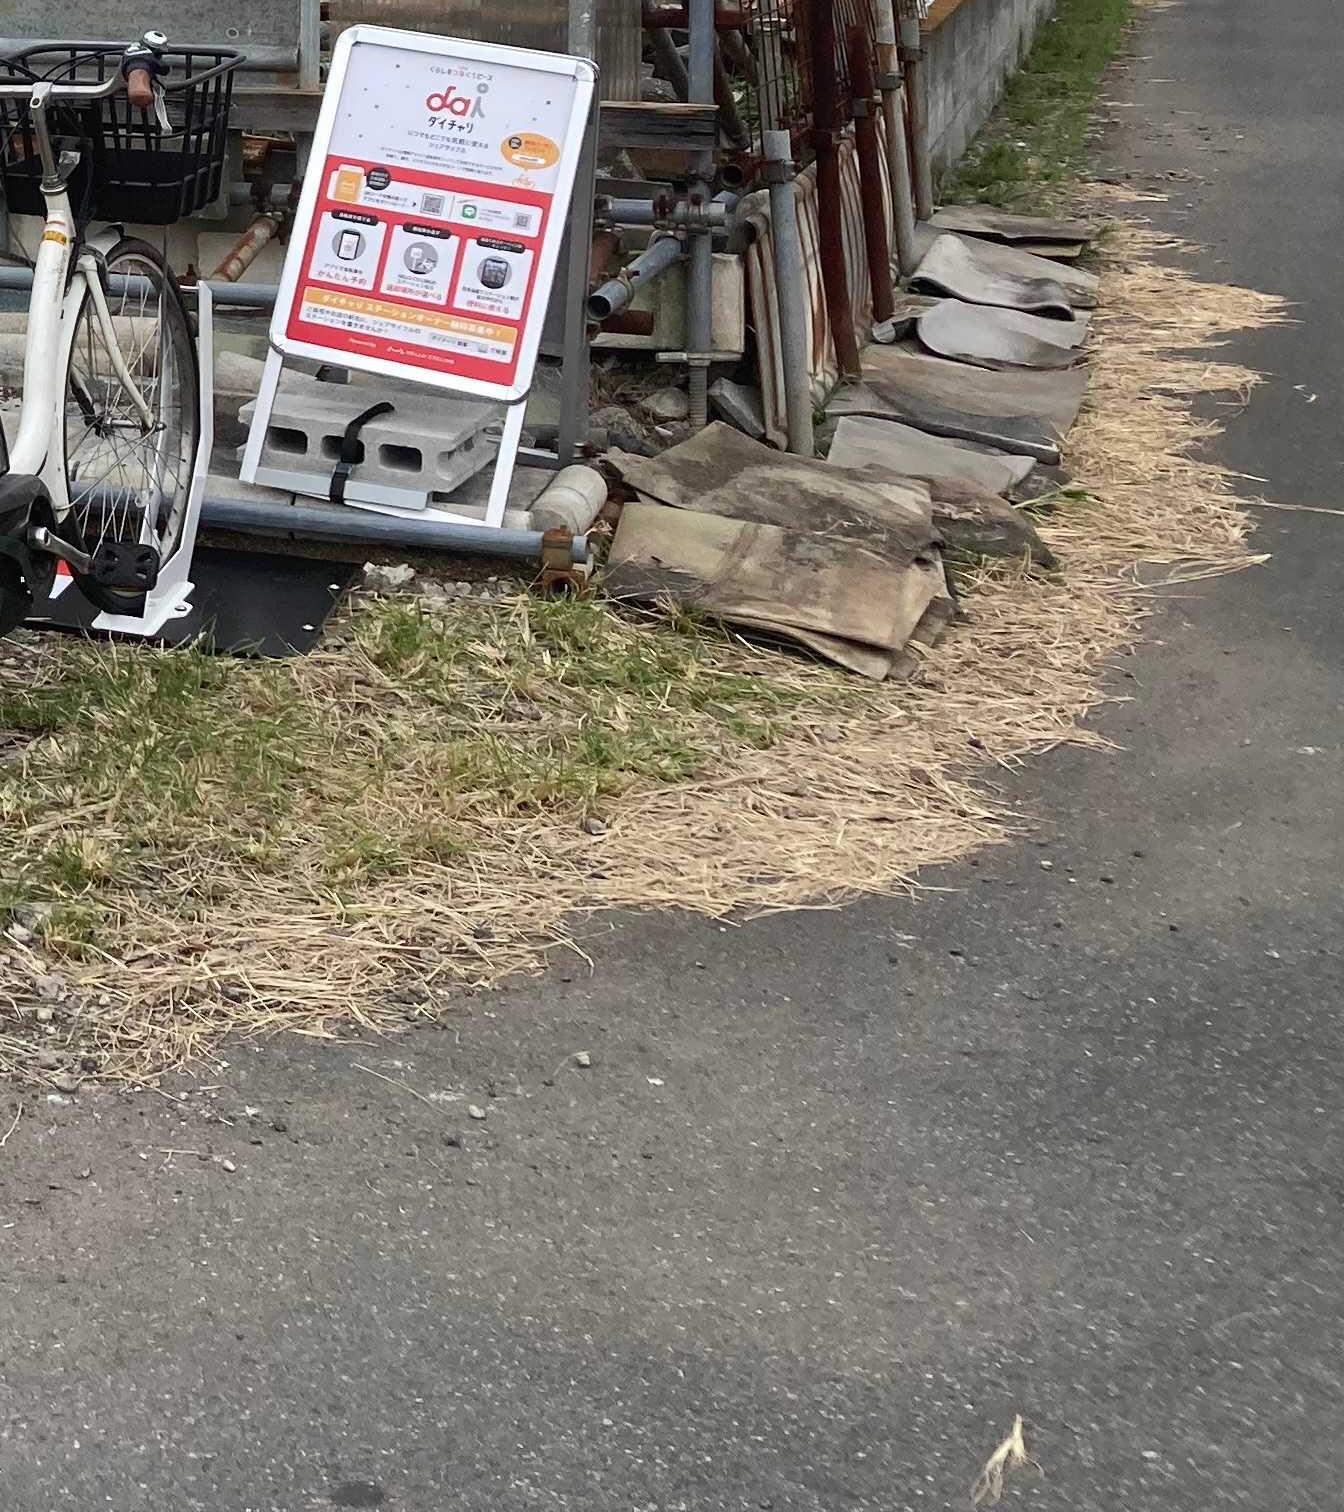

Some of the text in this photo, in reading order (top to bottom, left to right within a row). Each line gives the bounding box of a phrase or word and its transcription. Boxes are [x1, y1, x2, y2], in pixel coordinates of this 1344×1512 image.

[426, 115, 474, 134] ダイチャリ
[316, 269, 367, 286] かんたん予約
